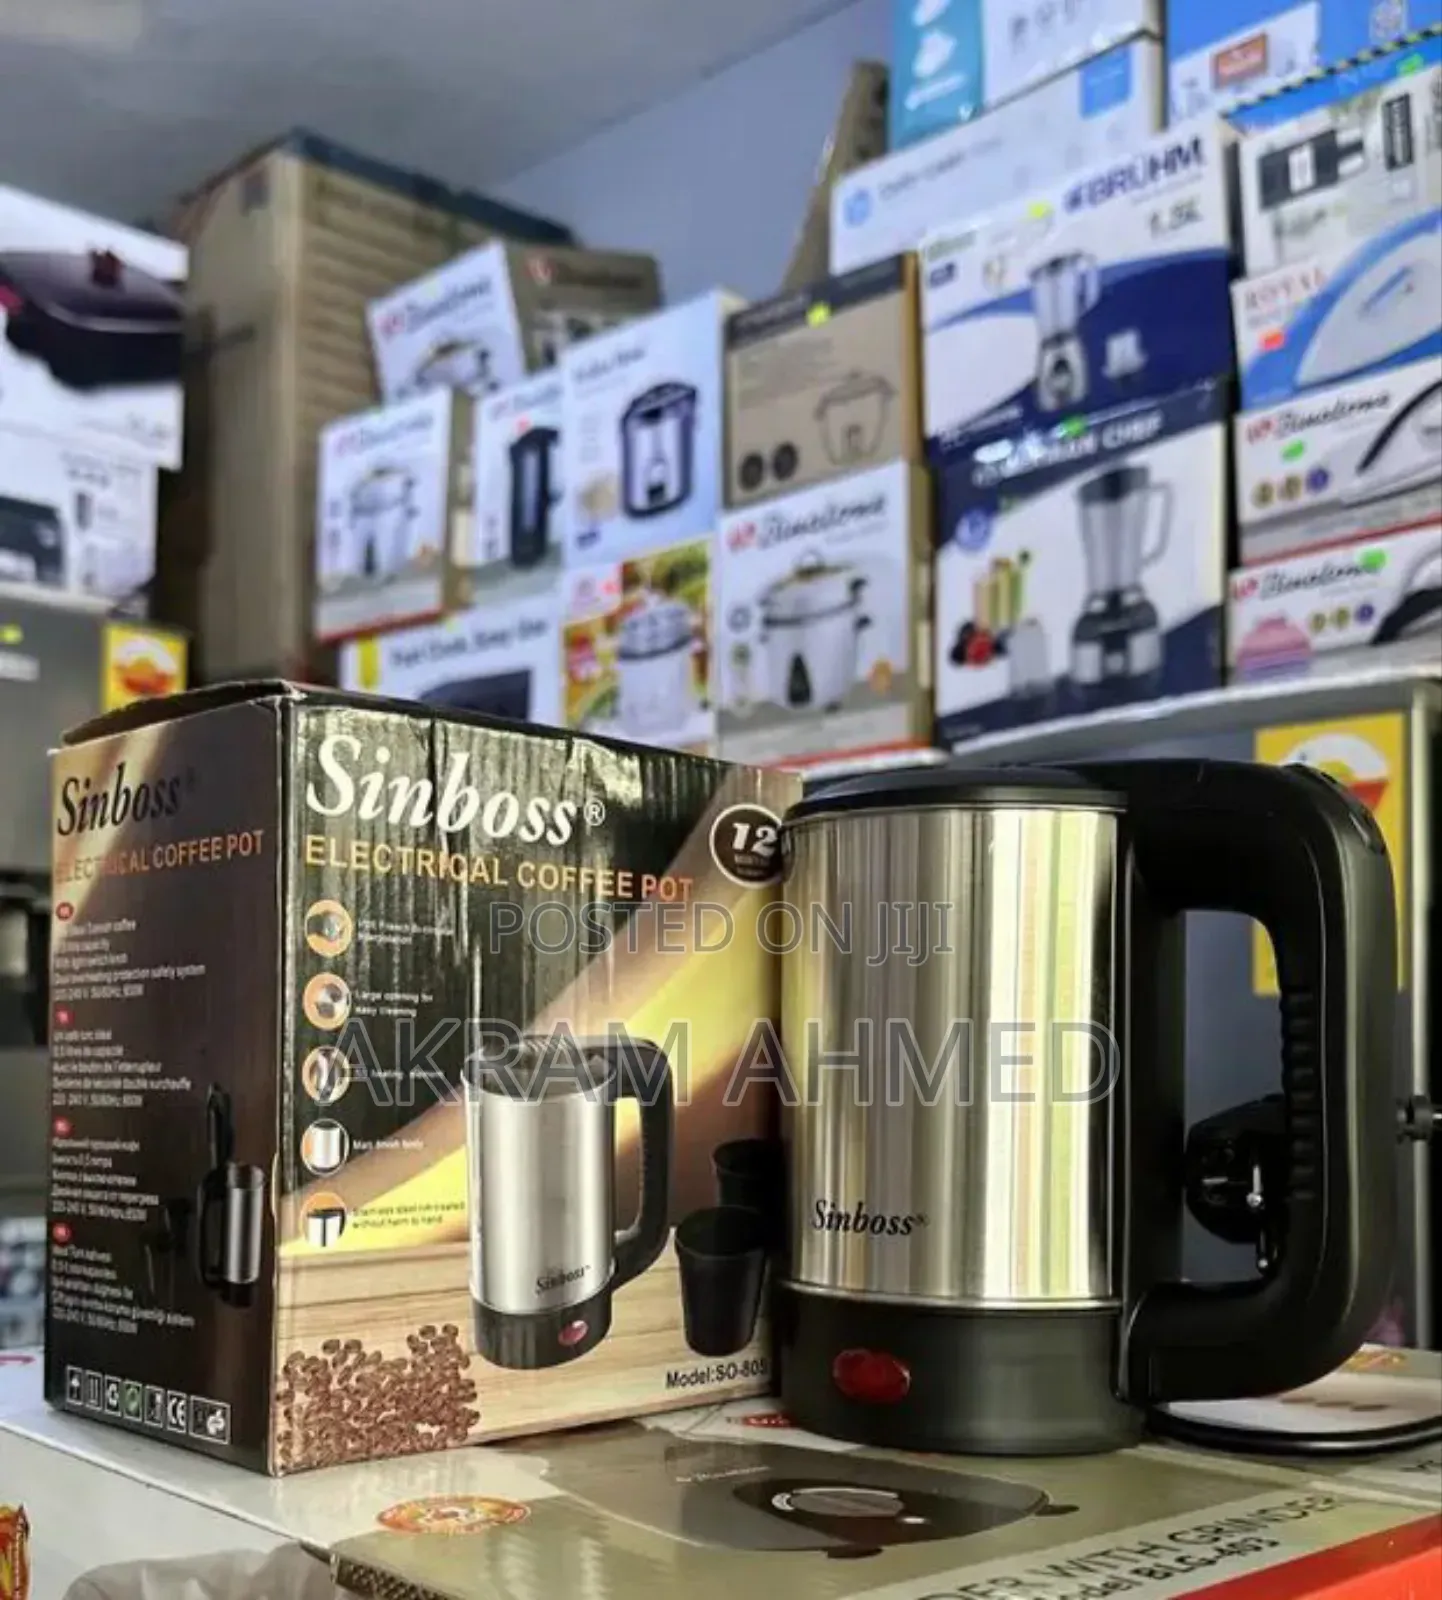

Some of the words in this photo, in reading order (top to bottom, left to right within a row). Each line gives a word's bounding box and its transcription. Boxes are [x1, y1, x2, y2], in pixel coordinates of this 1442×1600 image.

[152, 835, 222, 869] COFFEE
[227, 829, 265, 861] POT
[732, 822, 778, 858] 12
[306, 833, 510, 886] ELECTRICAL
[517, 860, 634, 899] COFFEE
[641, 873, 695, 902] POT
[1024, 1540, 1182, 1579] WITH
